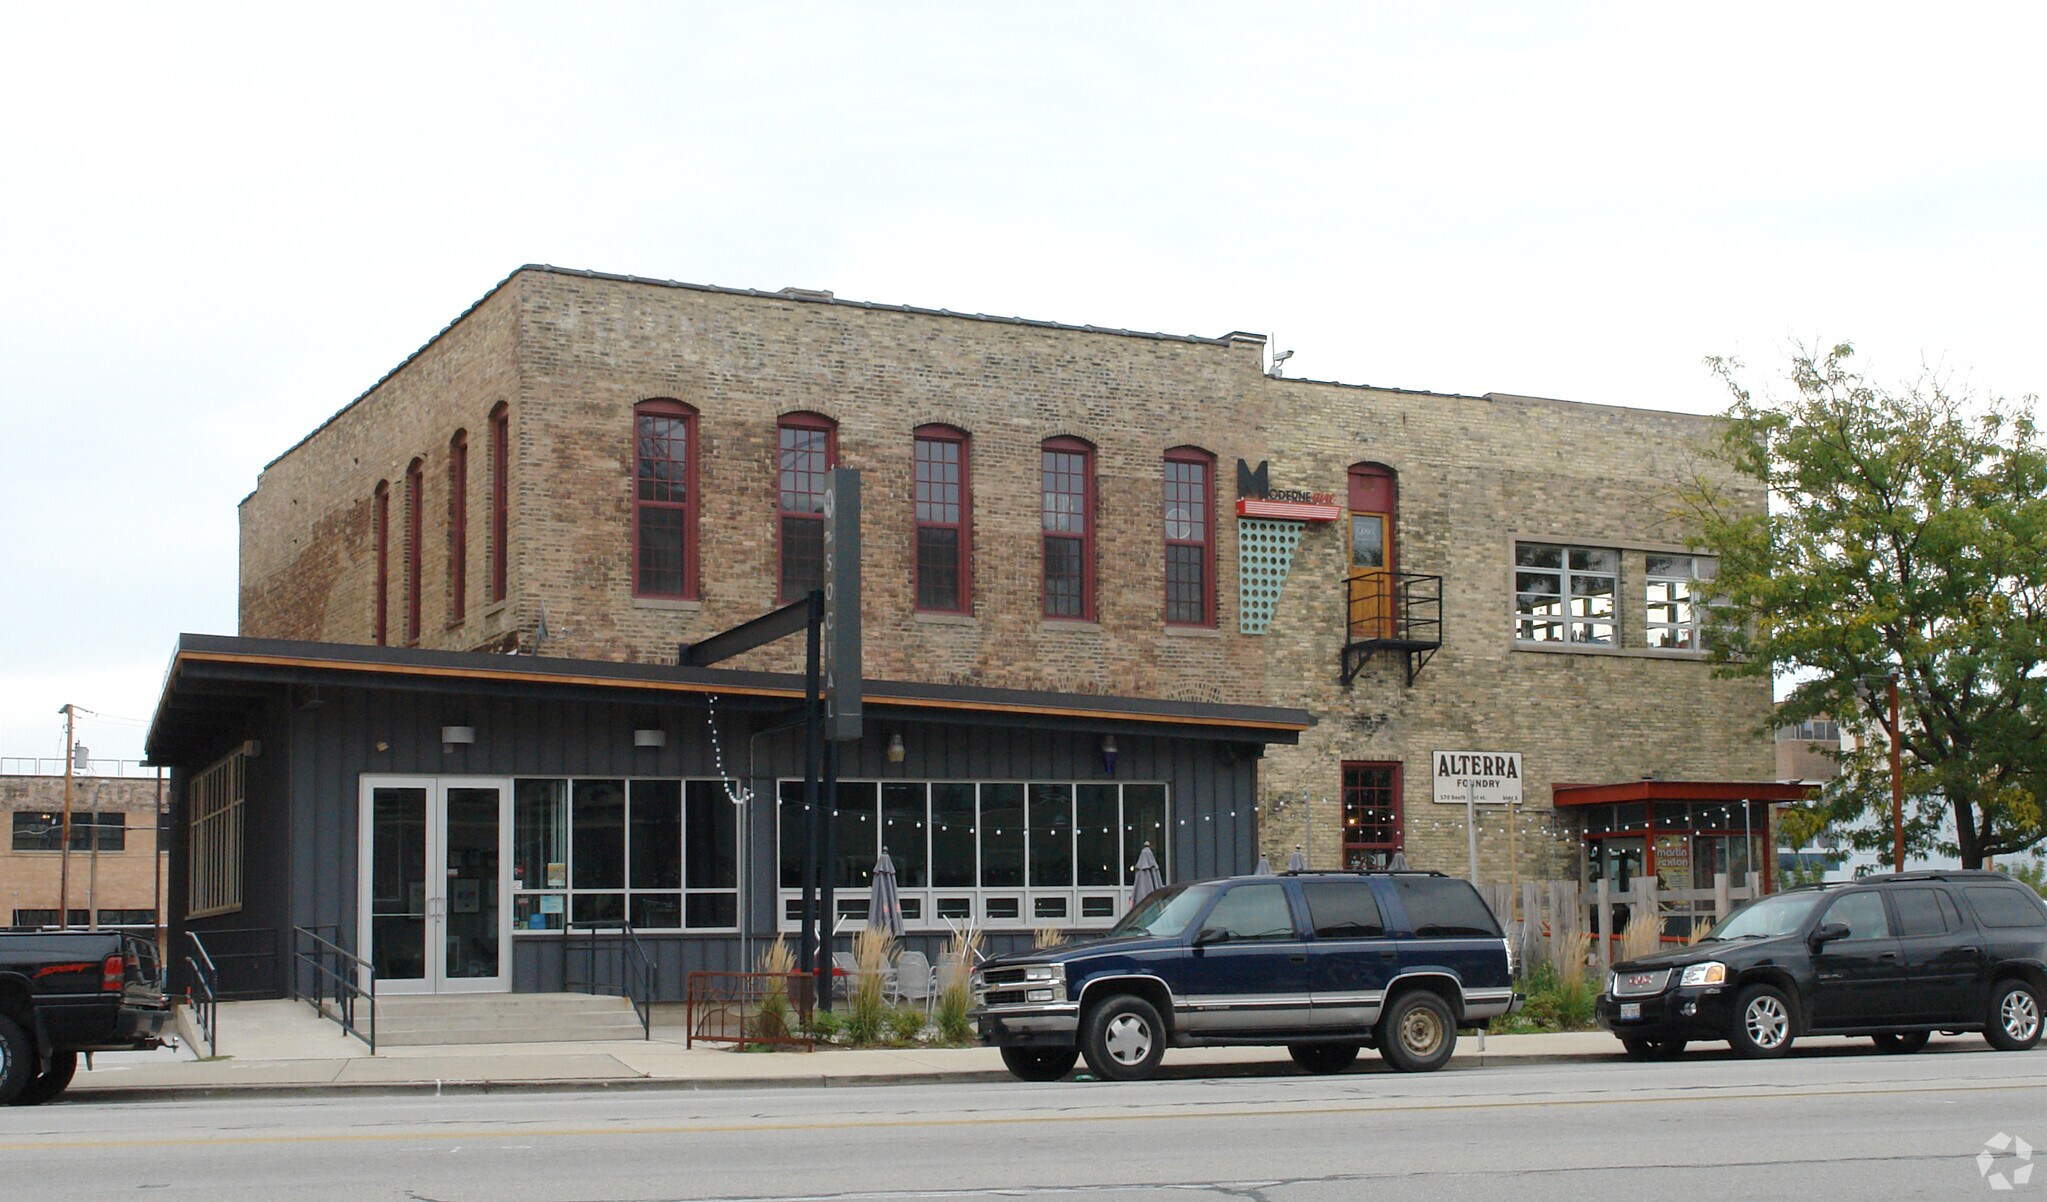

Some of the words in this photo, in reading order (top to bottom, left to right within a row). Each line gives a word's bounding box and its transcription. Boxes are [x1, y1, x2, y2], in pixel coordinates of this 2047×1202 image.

[825, 553, 835, 719] SOCIAL
[1438, 754, 1519, 779] ALTERRA
[1657, 848, 1687, 857] martin
[1657, 857, 1688, 867] sexton
